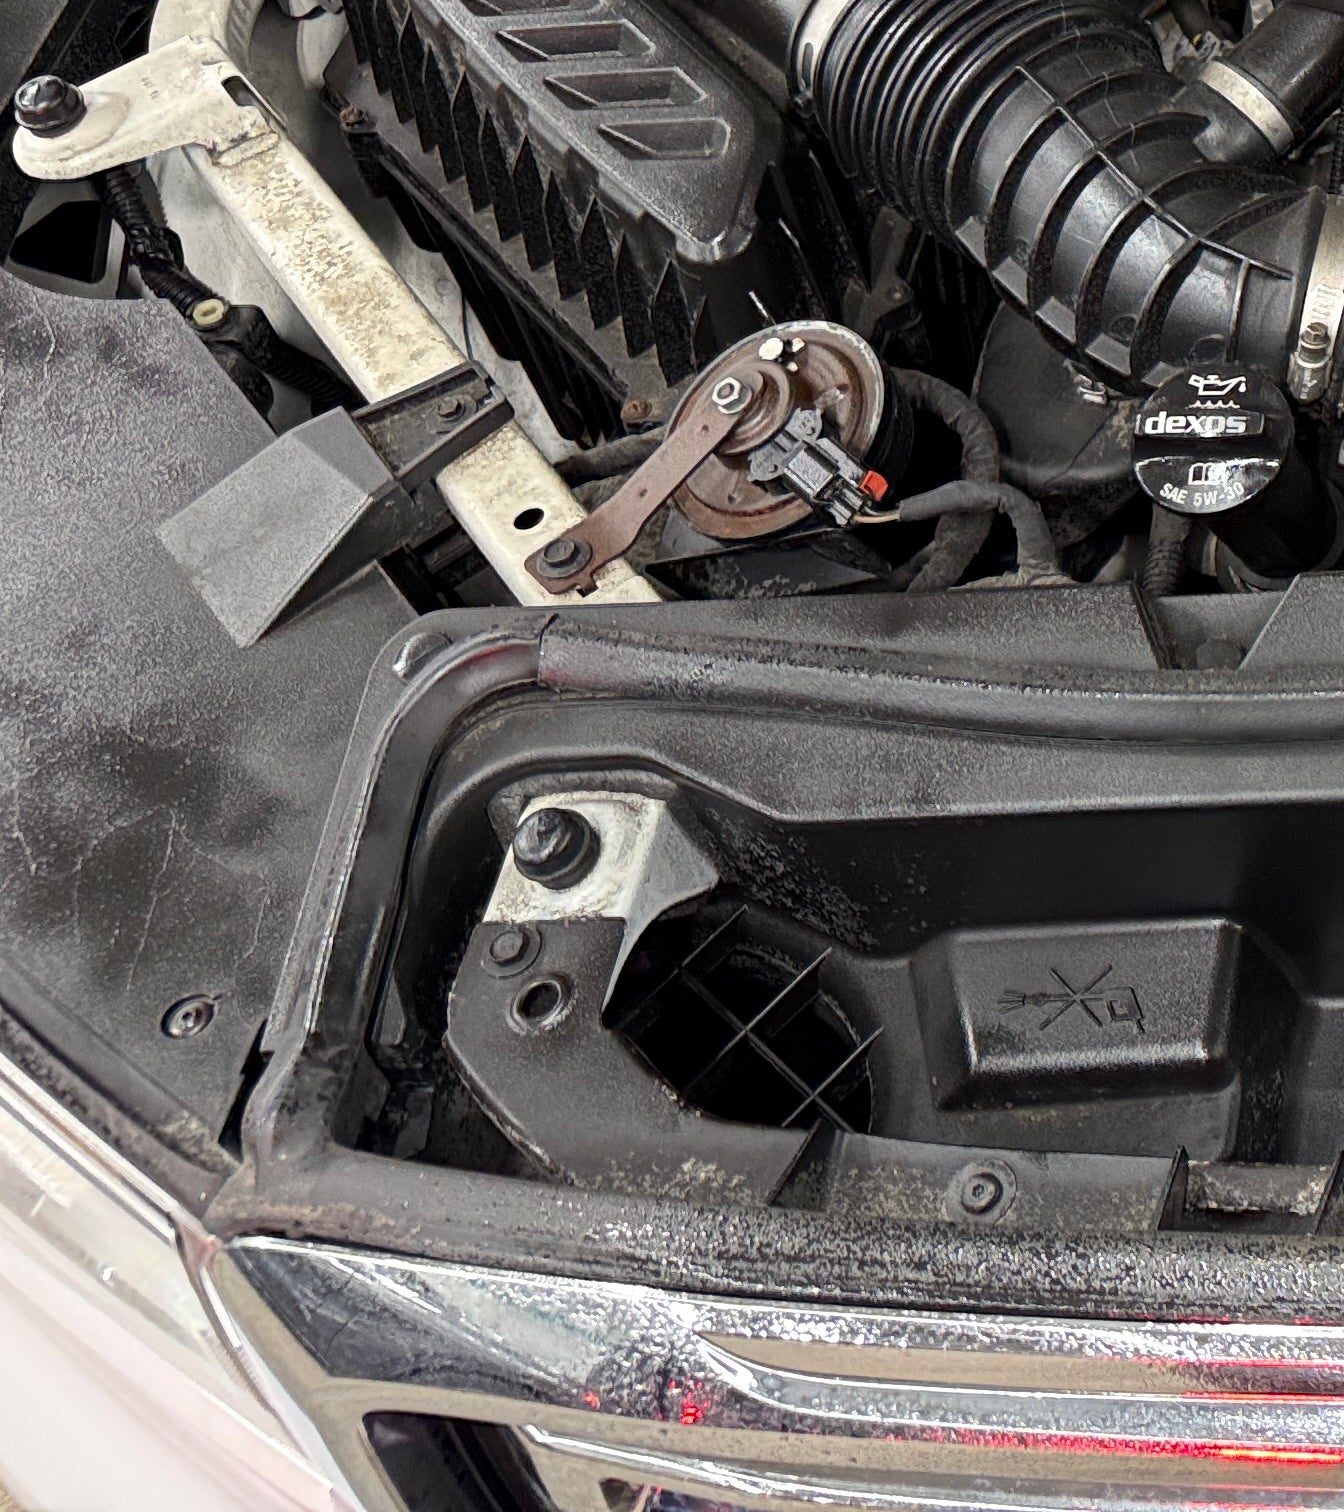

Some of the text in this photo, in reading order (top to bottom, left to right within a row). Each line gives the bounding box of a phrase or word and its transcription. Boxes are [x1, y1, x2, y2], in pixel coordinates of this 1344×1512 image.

[1144, 411, 1247, 434] dexos
[1160, 481, 1245, 506] SAE 5W-30
